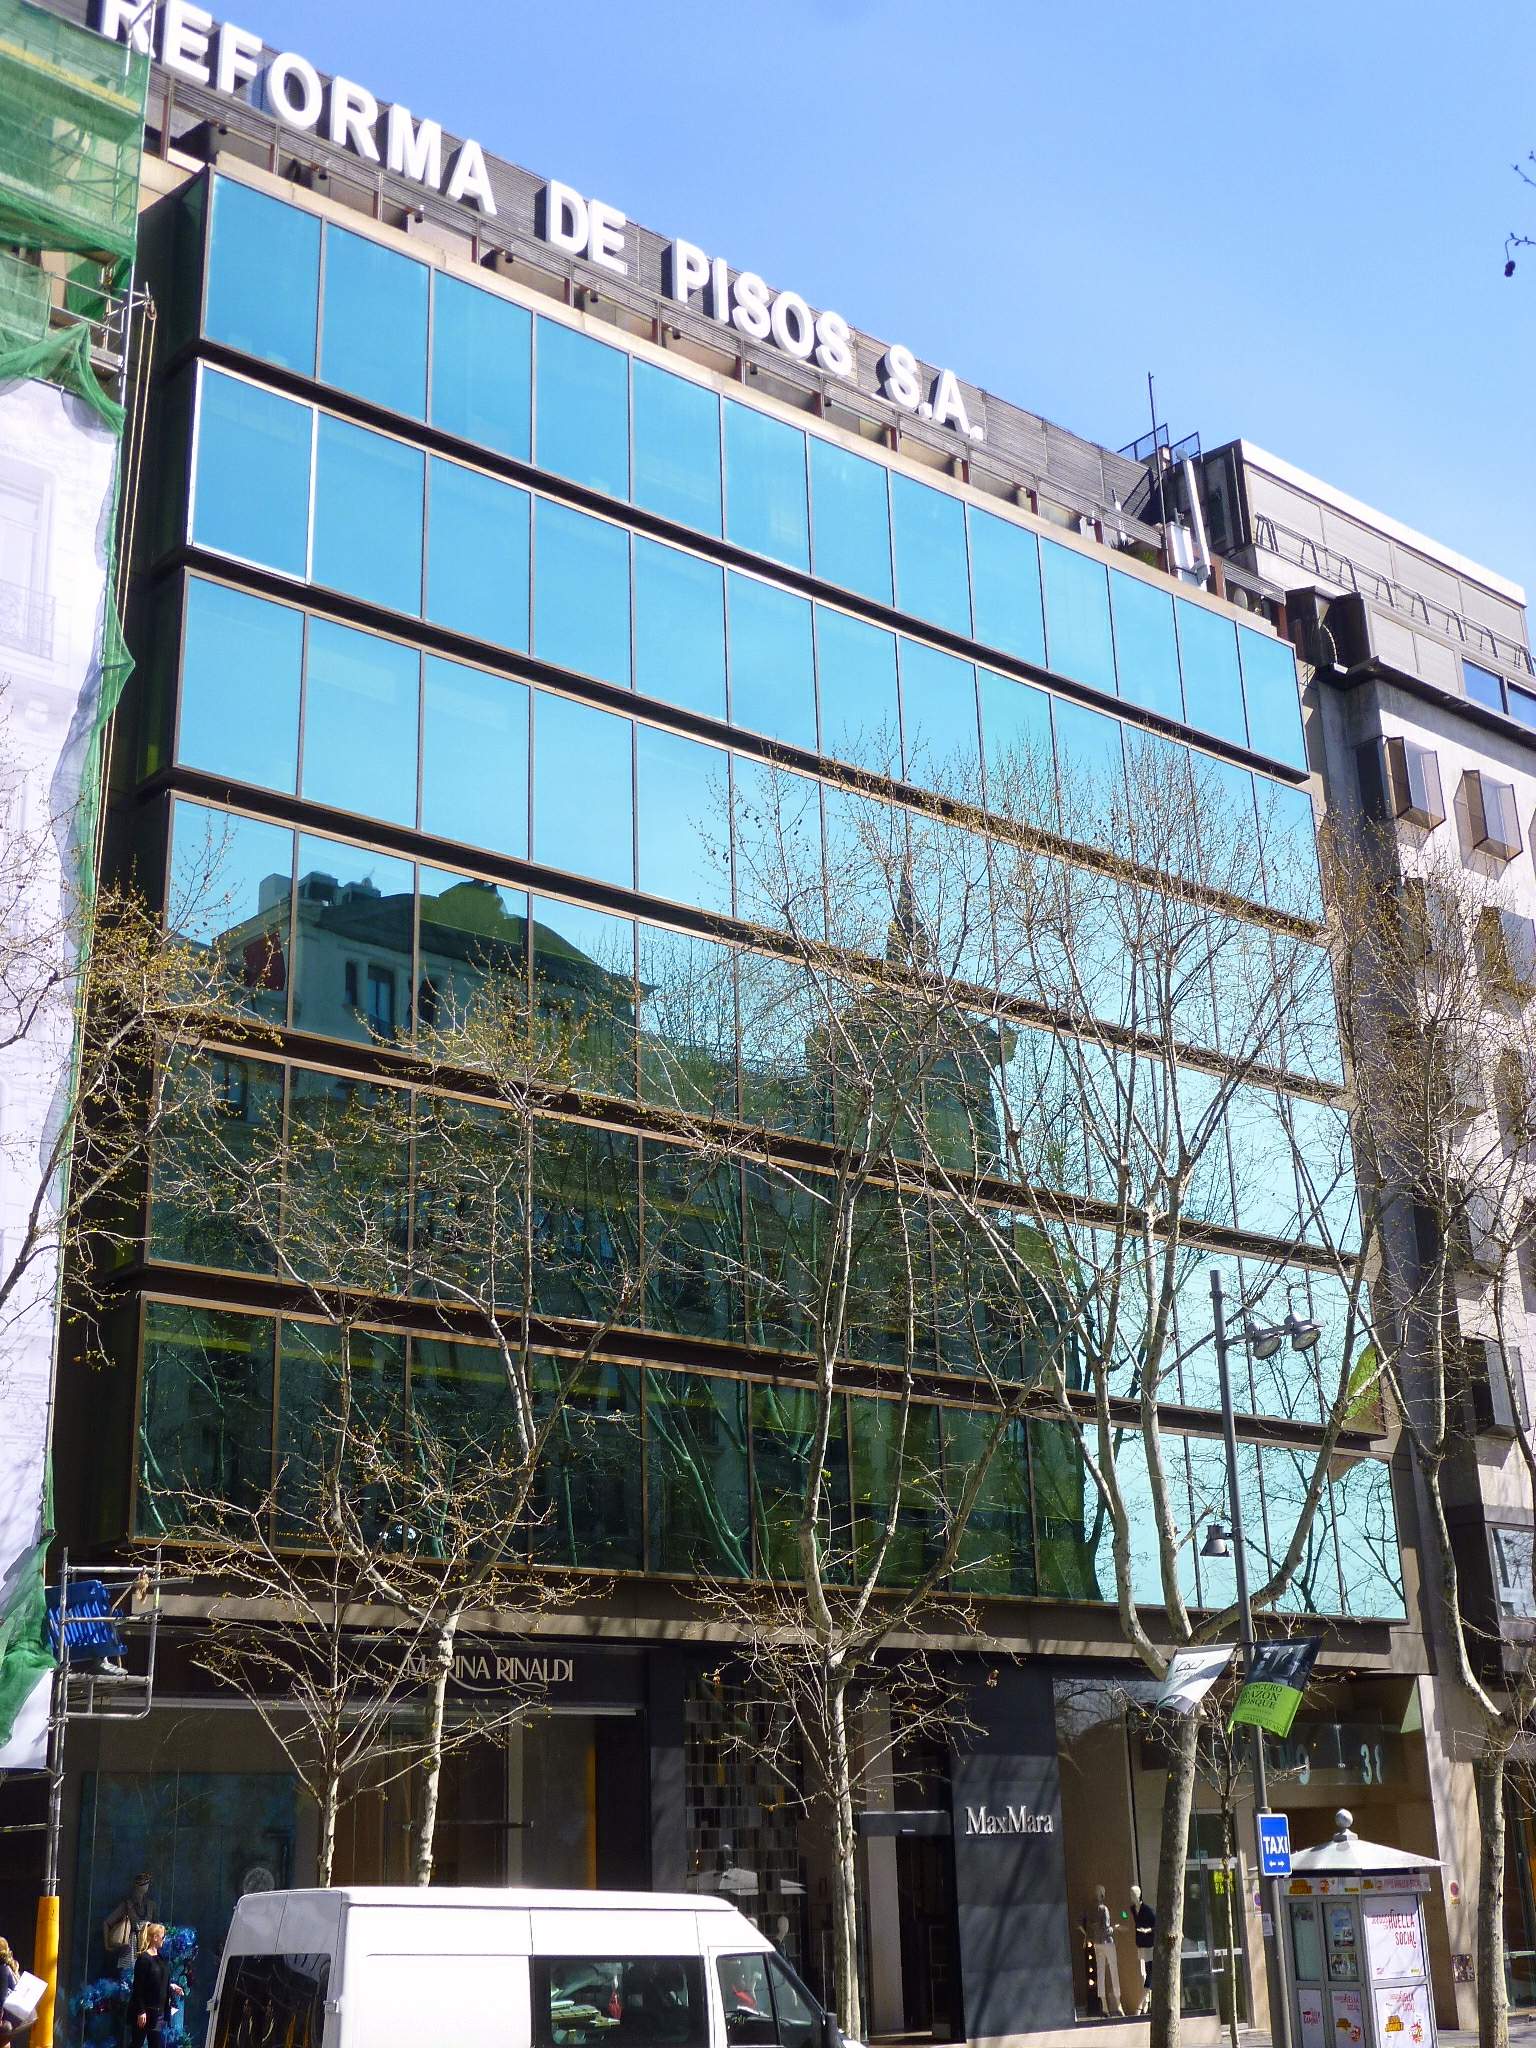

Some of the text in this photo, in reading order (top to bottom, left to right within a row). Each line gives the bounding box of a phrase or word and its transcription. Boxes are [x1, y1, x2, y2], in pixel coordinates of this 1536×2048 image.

[100, 0, 985, 442] REFORMA DE PISOS S.A.
[496, 1656, 574, 1684] RINALDI
[965, 1804, 1055, 1835] MaxMara
[1262, 1835, 1289, 1855] TAXI
[1394, 1930, 1417, 1949] SOCIAL
